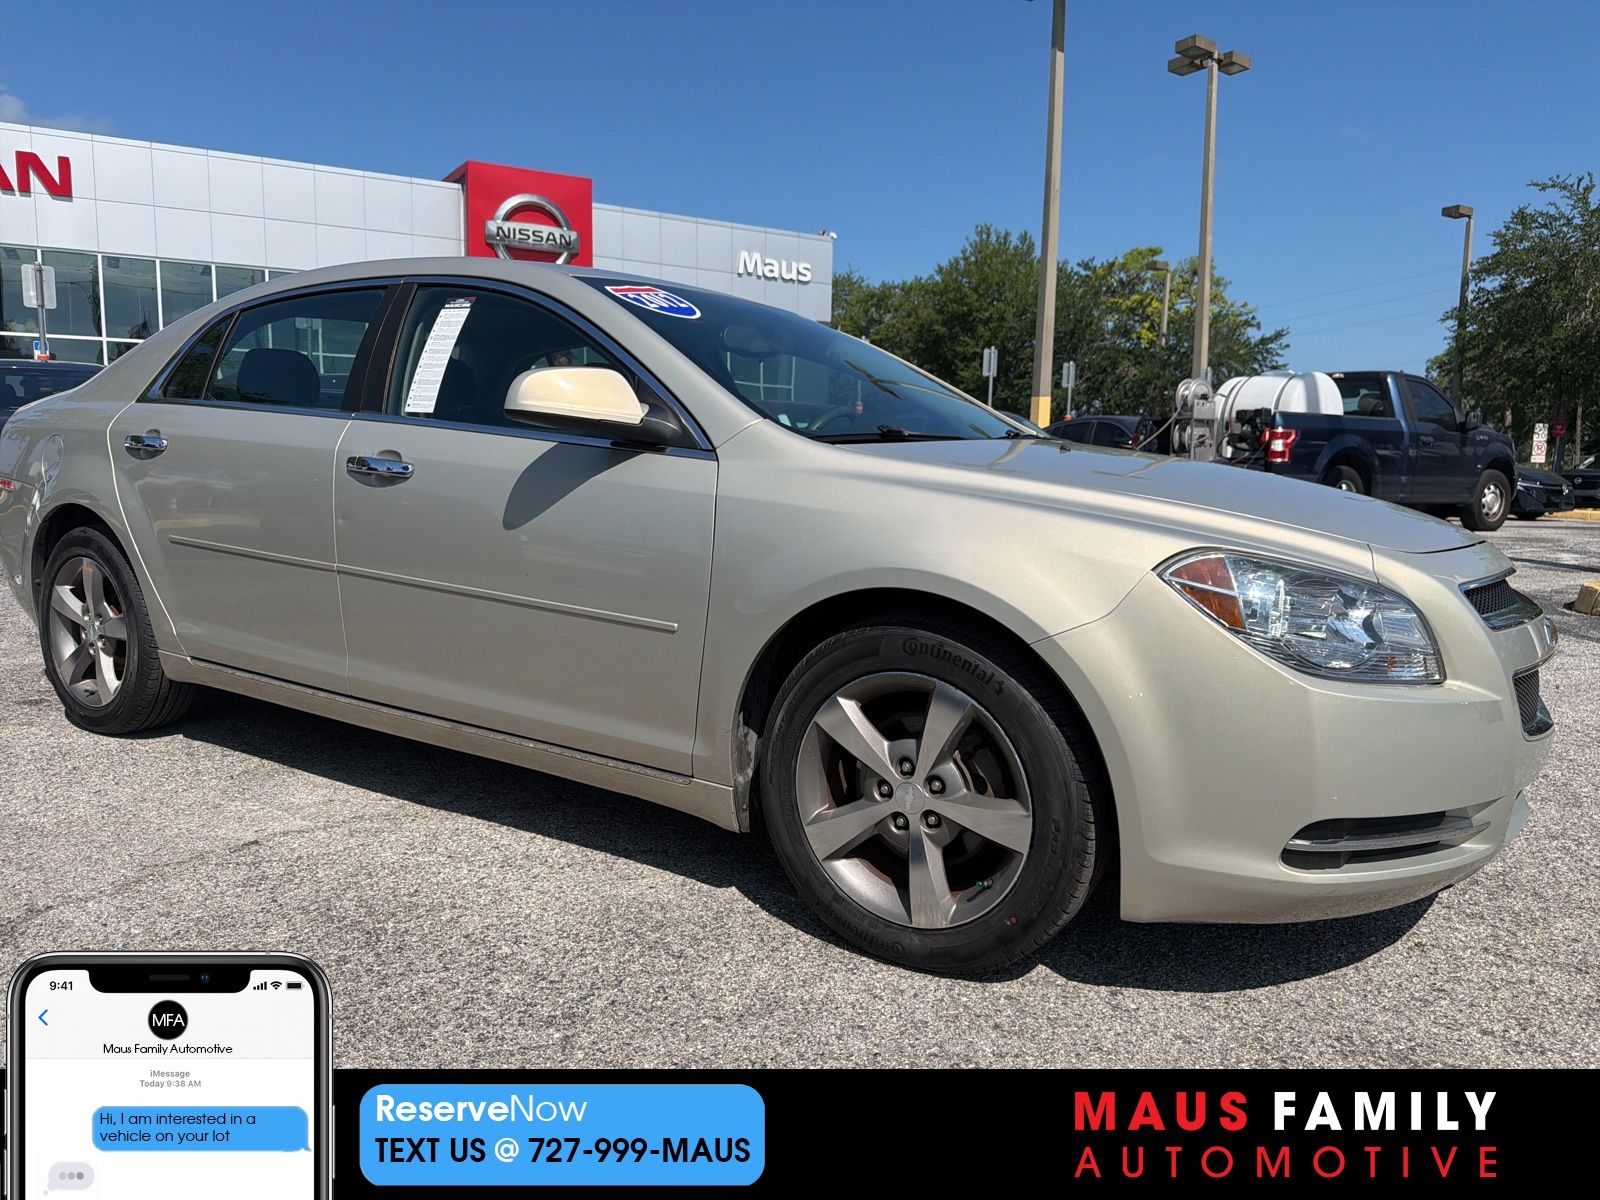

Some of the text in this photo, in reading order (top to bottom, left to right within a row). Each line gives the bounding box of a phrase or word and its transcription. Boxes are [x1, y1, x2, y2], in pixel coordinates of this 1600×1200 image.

[0, 150, 72, 198] N
[496, 226, 573, 246] NISSAN
[738, 250, 812, 282] Maus
[627, 292, 690, 309] 2012
[902, 637, 996, 686] Continental
